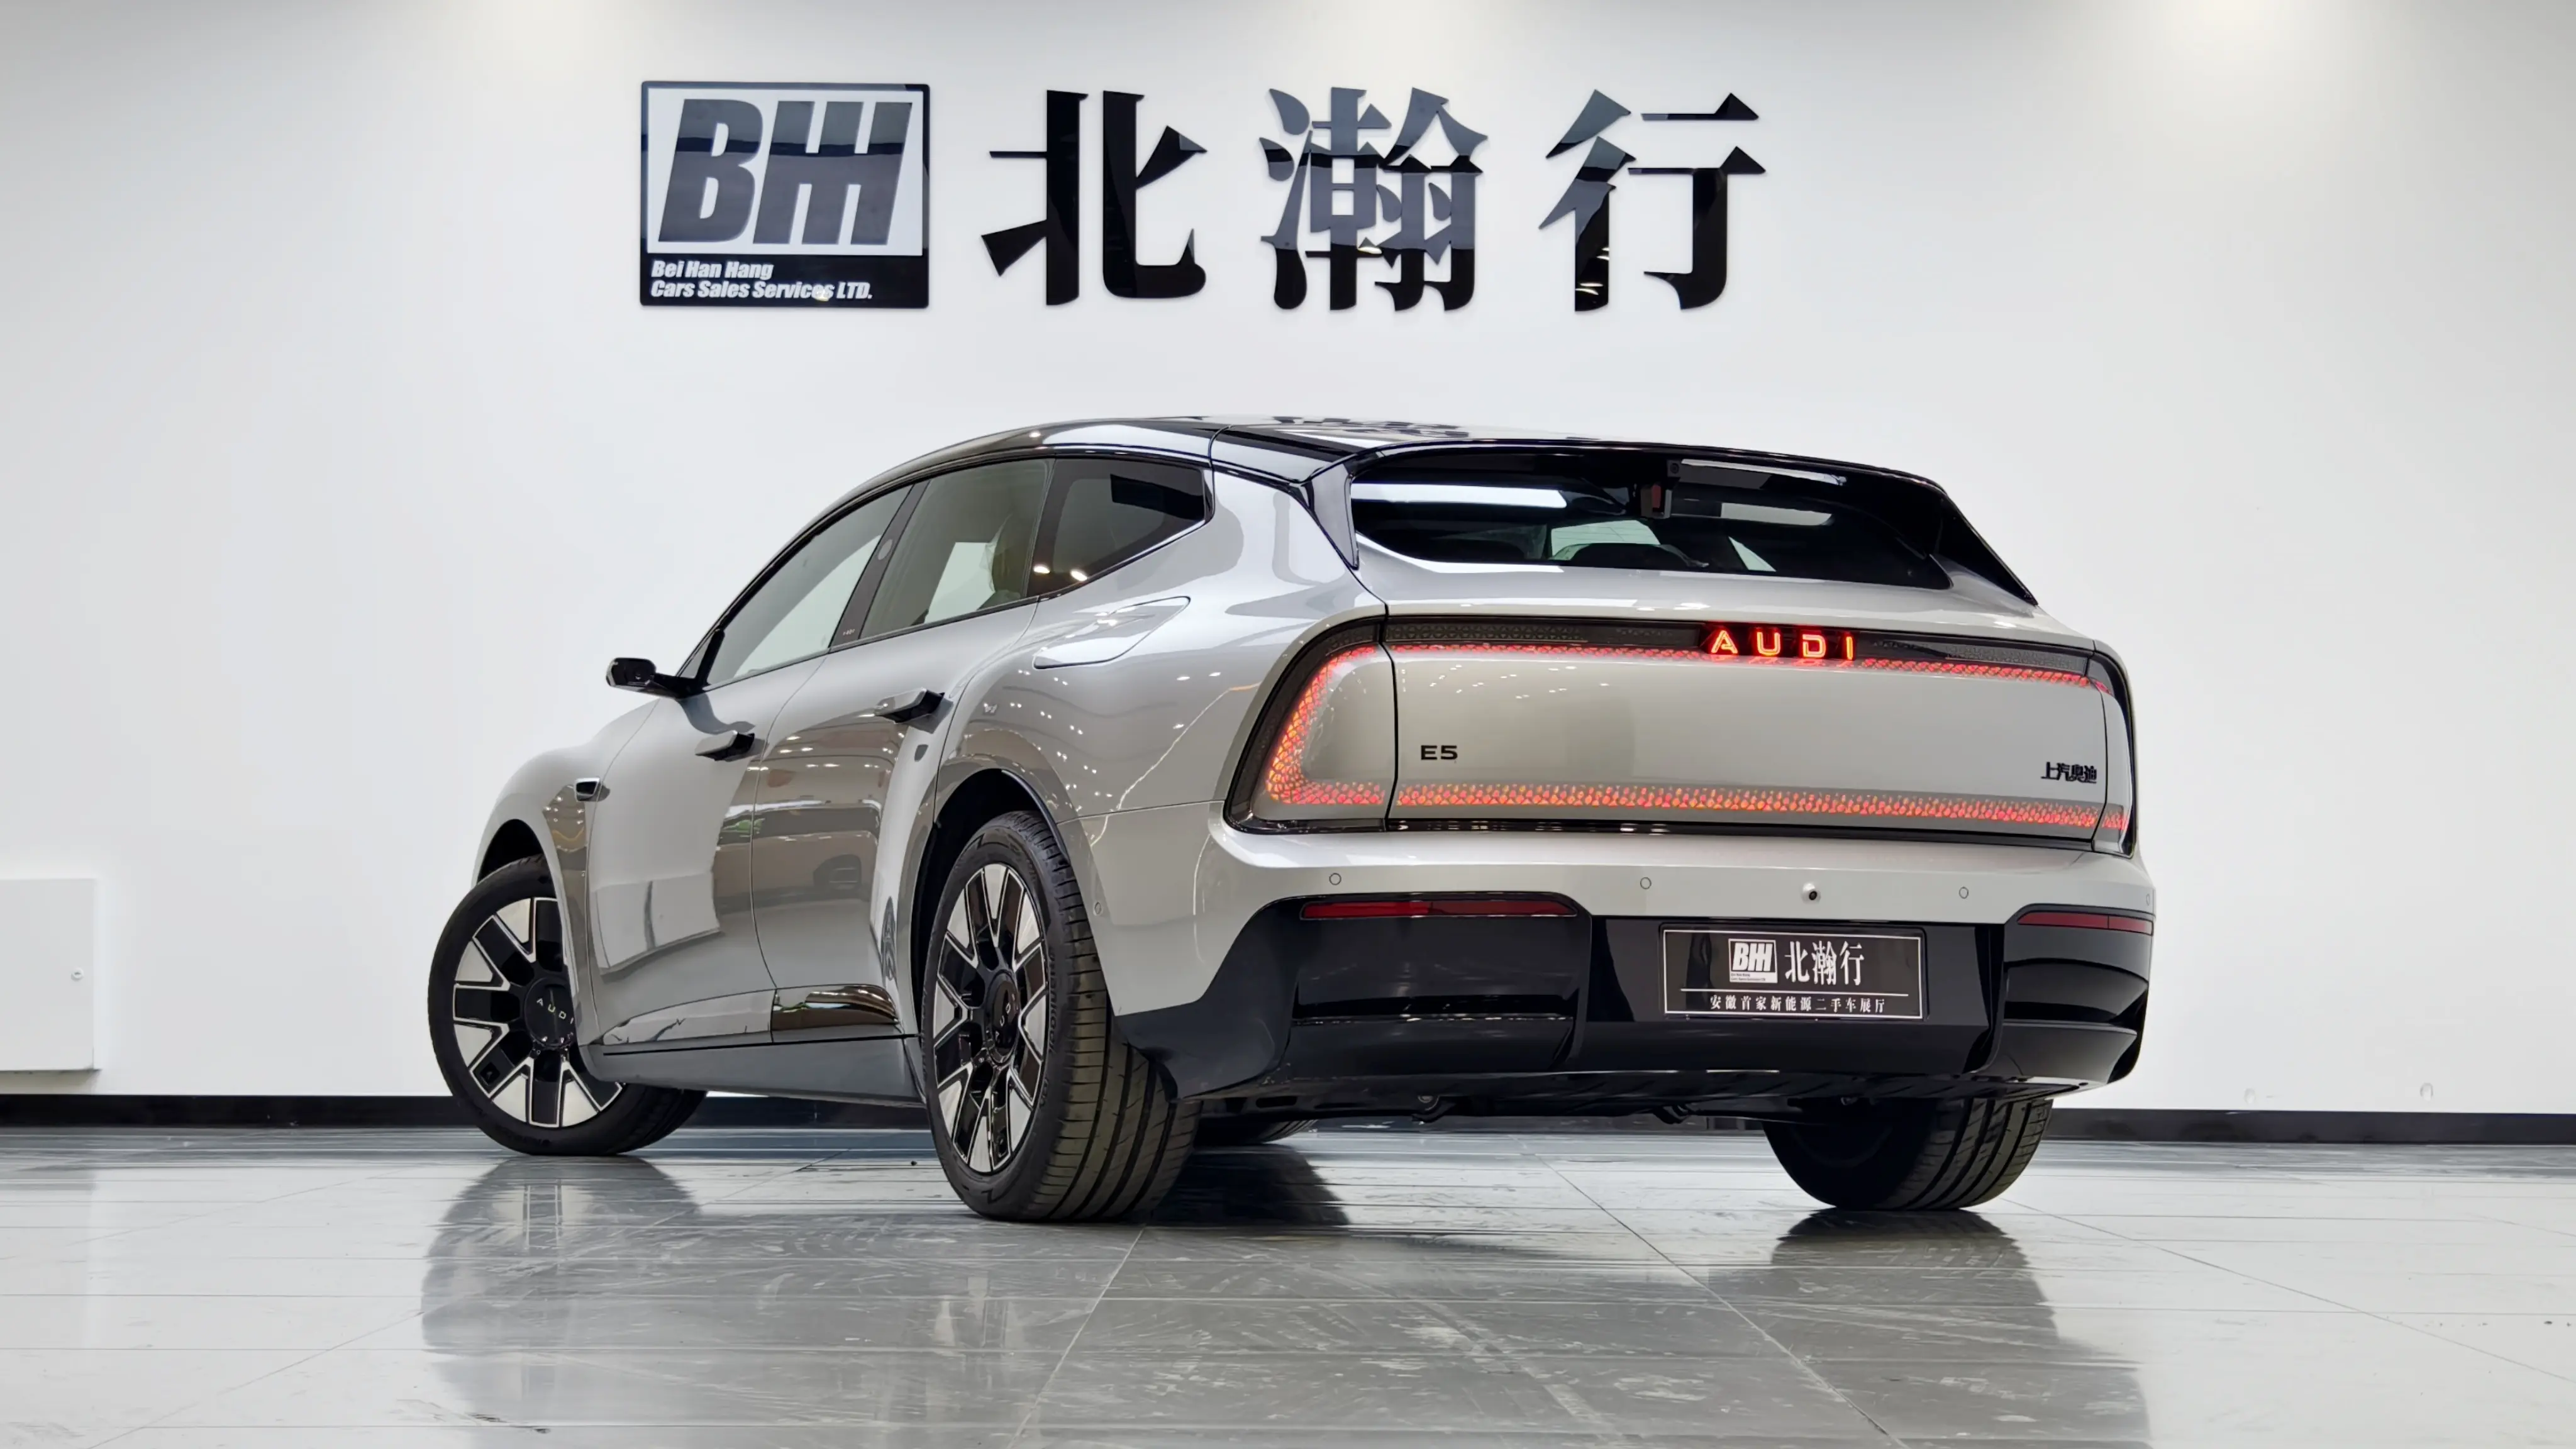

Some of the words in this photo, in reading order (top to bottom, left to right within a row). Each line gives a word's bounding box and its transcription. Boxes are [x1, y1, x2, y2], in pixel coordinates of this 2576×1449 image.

[980, 87, 1767, 313] 北瀚行
[651, 260, 684, 278] Bei
[684, 261, 722, 278] Han
[724, 262, 774, 280] Hang
[650, 280, 695, 297] Cars
[697, 280, 750, 298] Sales
[752, 282, 835, 299] Services
[836, 282, 873, 299] LTD.
[1710, 630, 1854, 660] AUDI
[1421, 745, 1458, 760] E5
[2040, 761, 2097, 784] 上汽奥迪
[1784, 940, 1865, 986] 北瀚行
[536, 997, 574, 1024] AUDI
[1710, 994, 1885, 1013] 安徽首家新能源二手车展厅
[995, 993, 1015, 1041] AUDI
